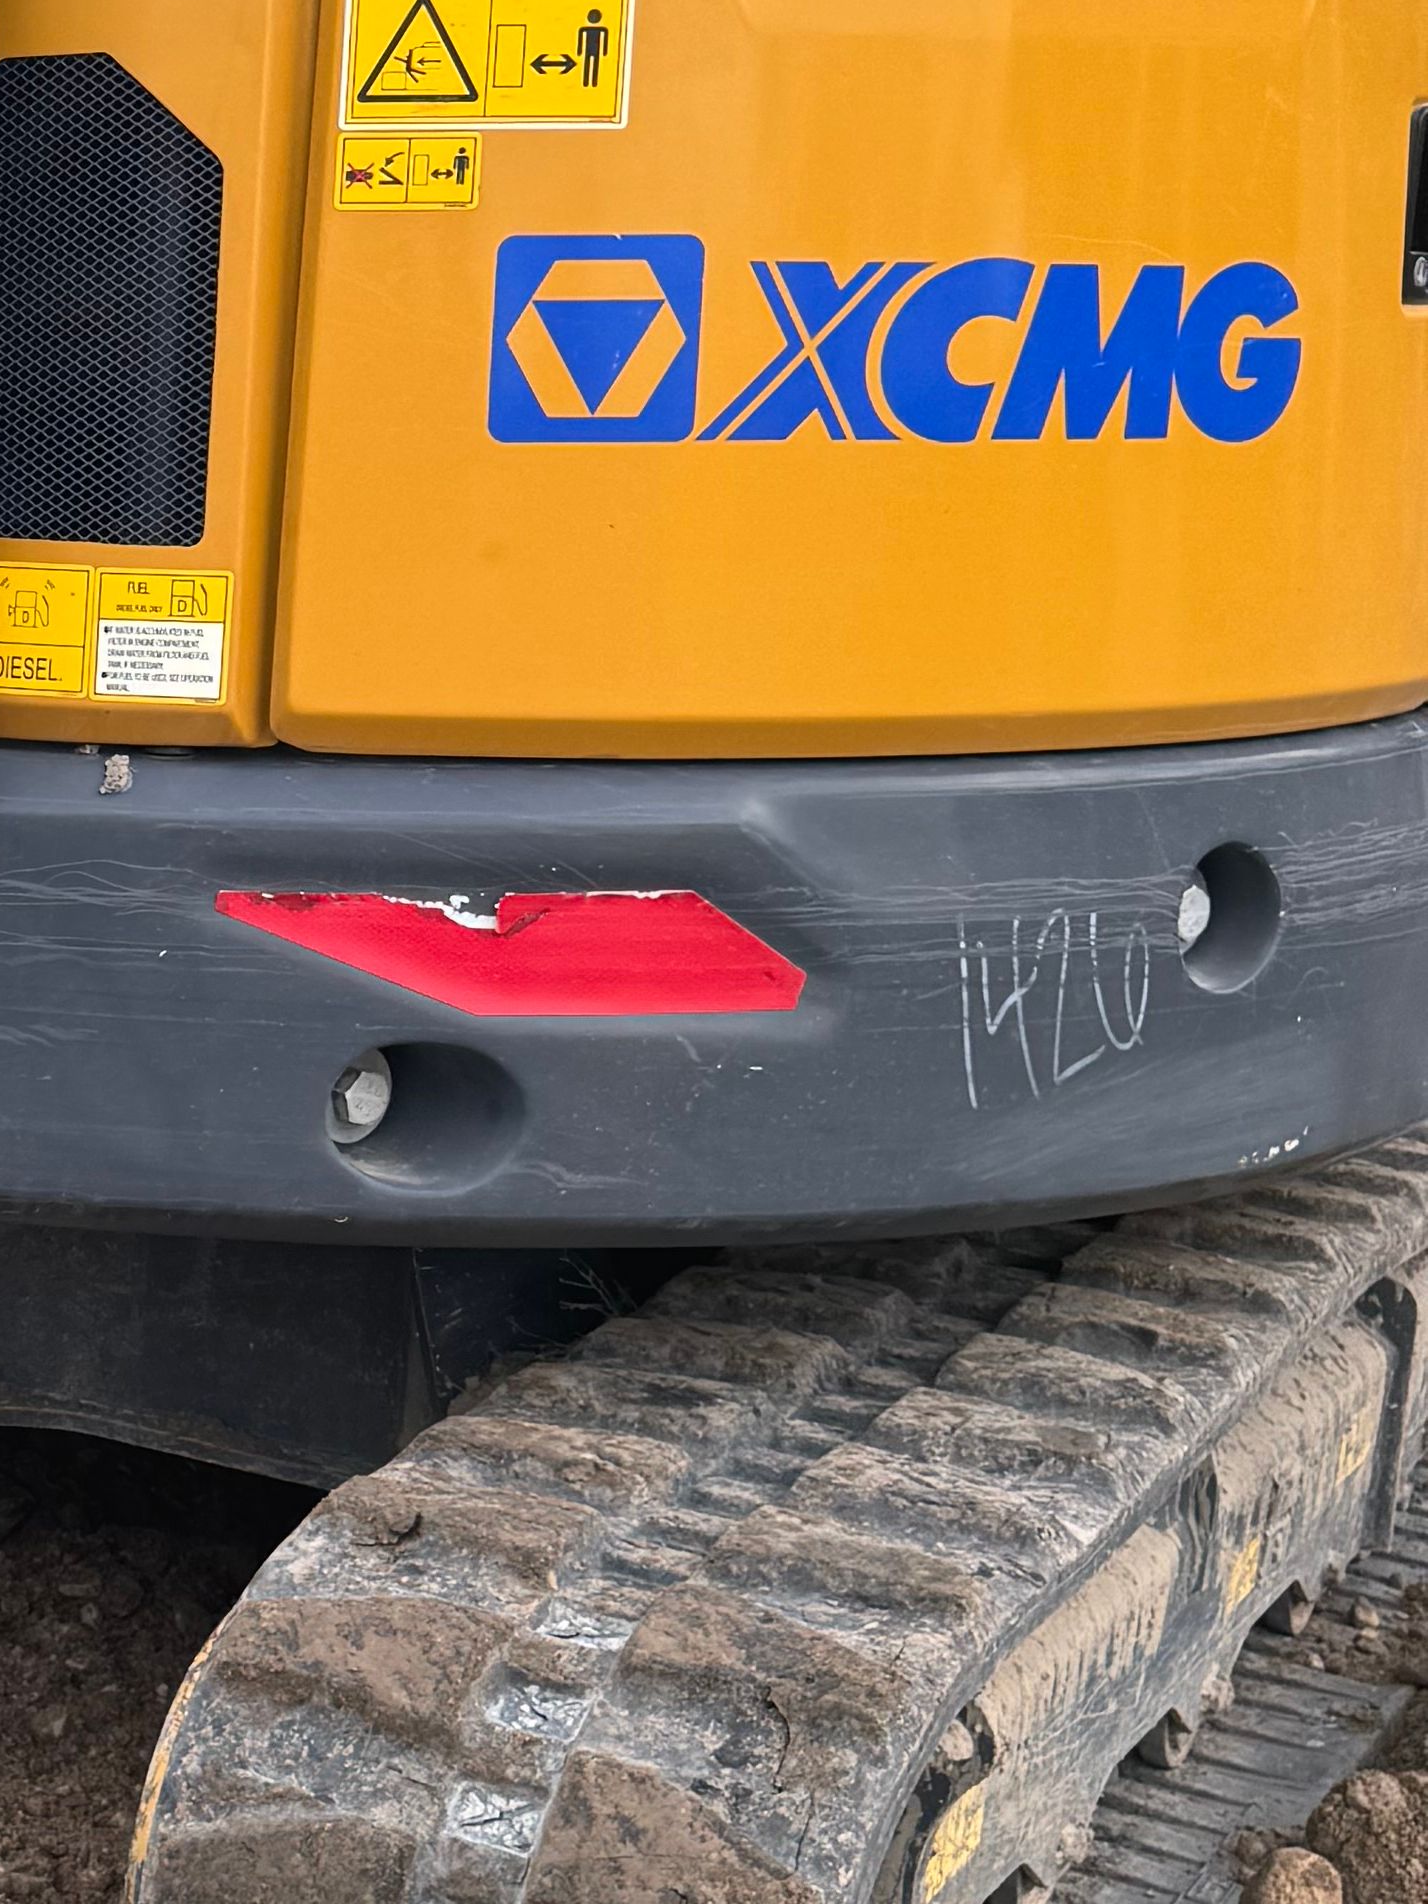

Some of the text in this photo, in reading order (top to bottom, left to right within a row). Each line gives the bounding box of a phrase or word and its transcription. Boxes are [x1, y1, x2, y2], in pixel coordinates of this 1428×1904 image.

[694, 256, 1302, 443] XCMG
[177, 599, 187, 613] D
[22, 610, 30, 624] D
